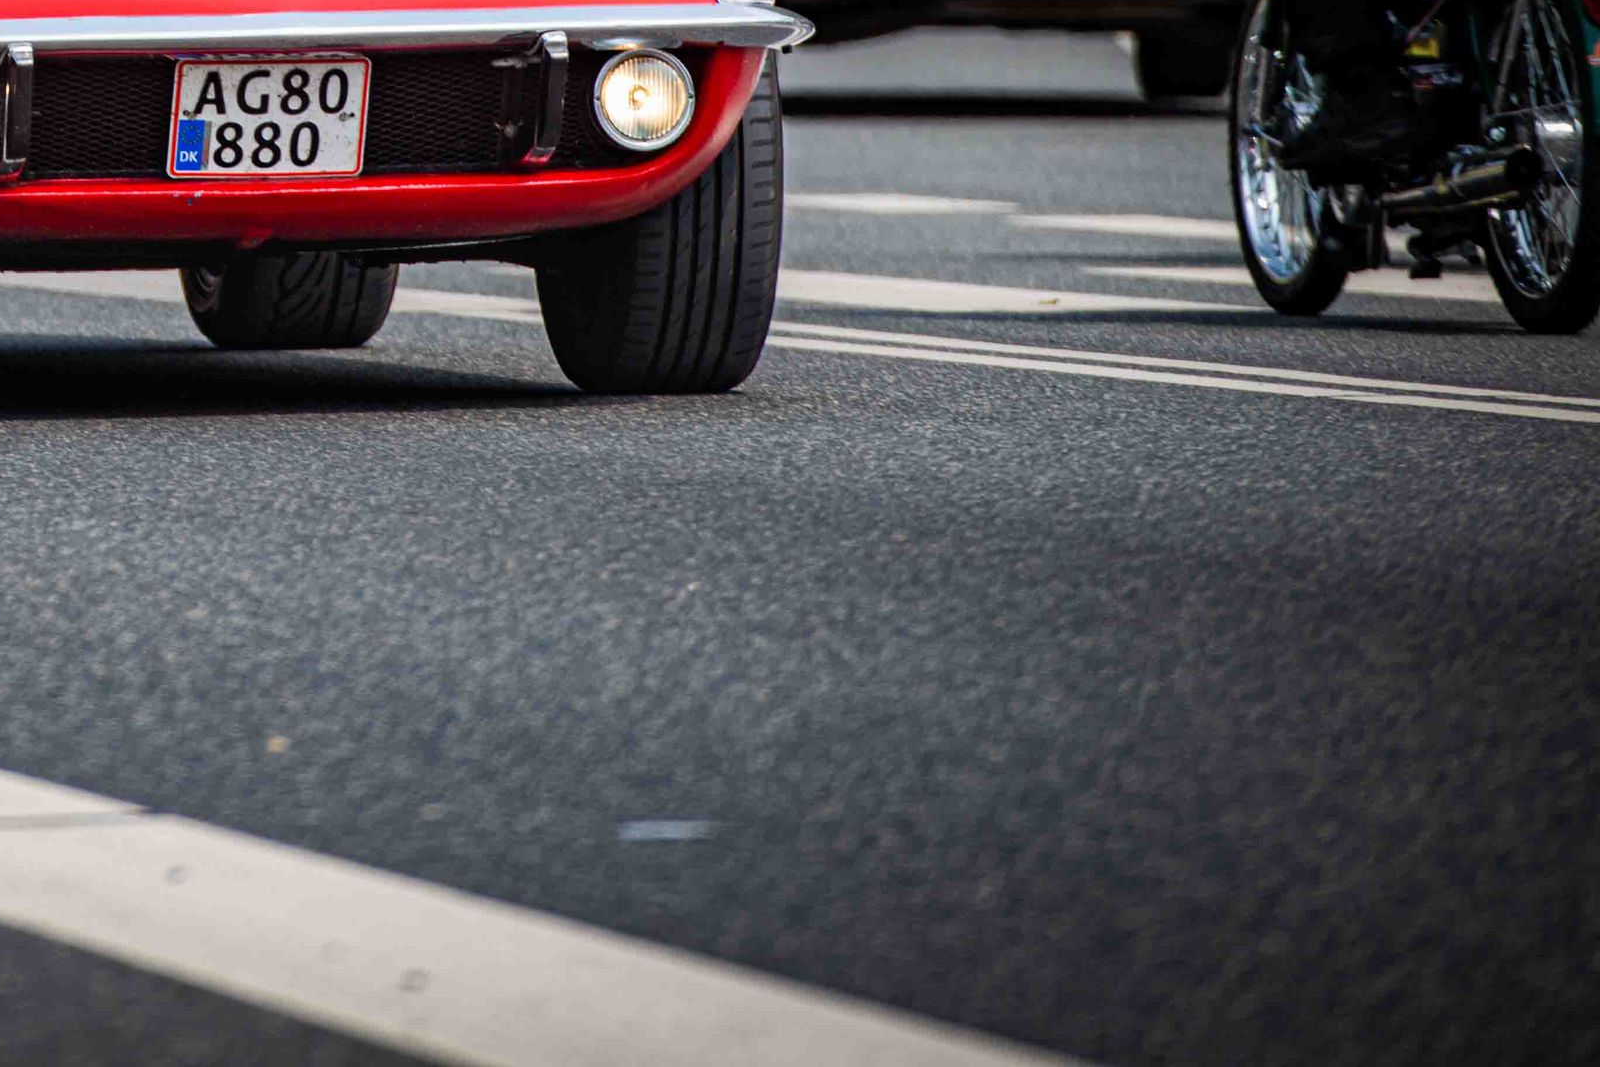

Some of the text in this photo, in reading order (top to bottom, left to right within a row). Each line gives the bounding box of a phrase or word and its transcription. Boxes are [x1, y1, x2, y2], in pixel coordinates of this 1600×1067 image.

[193, 67, 350, 116] AG80
[179, 120, 321, 169] DK 880
